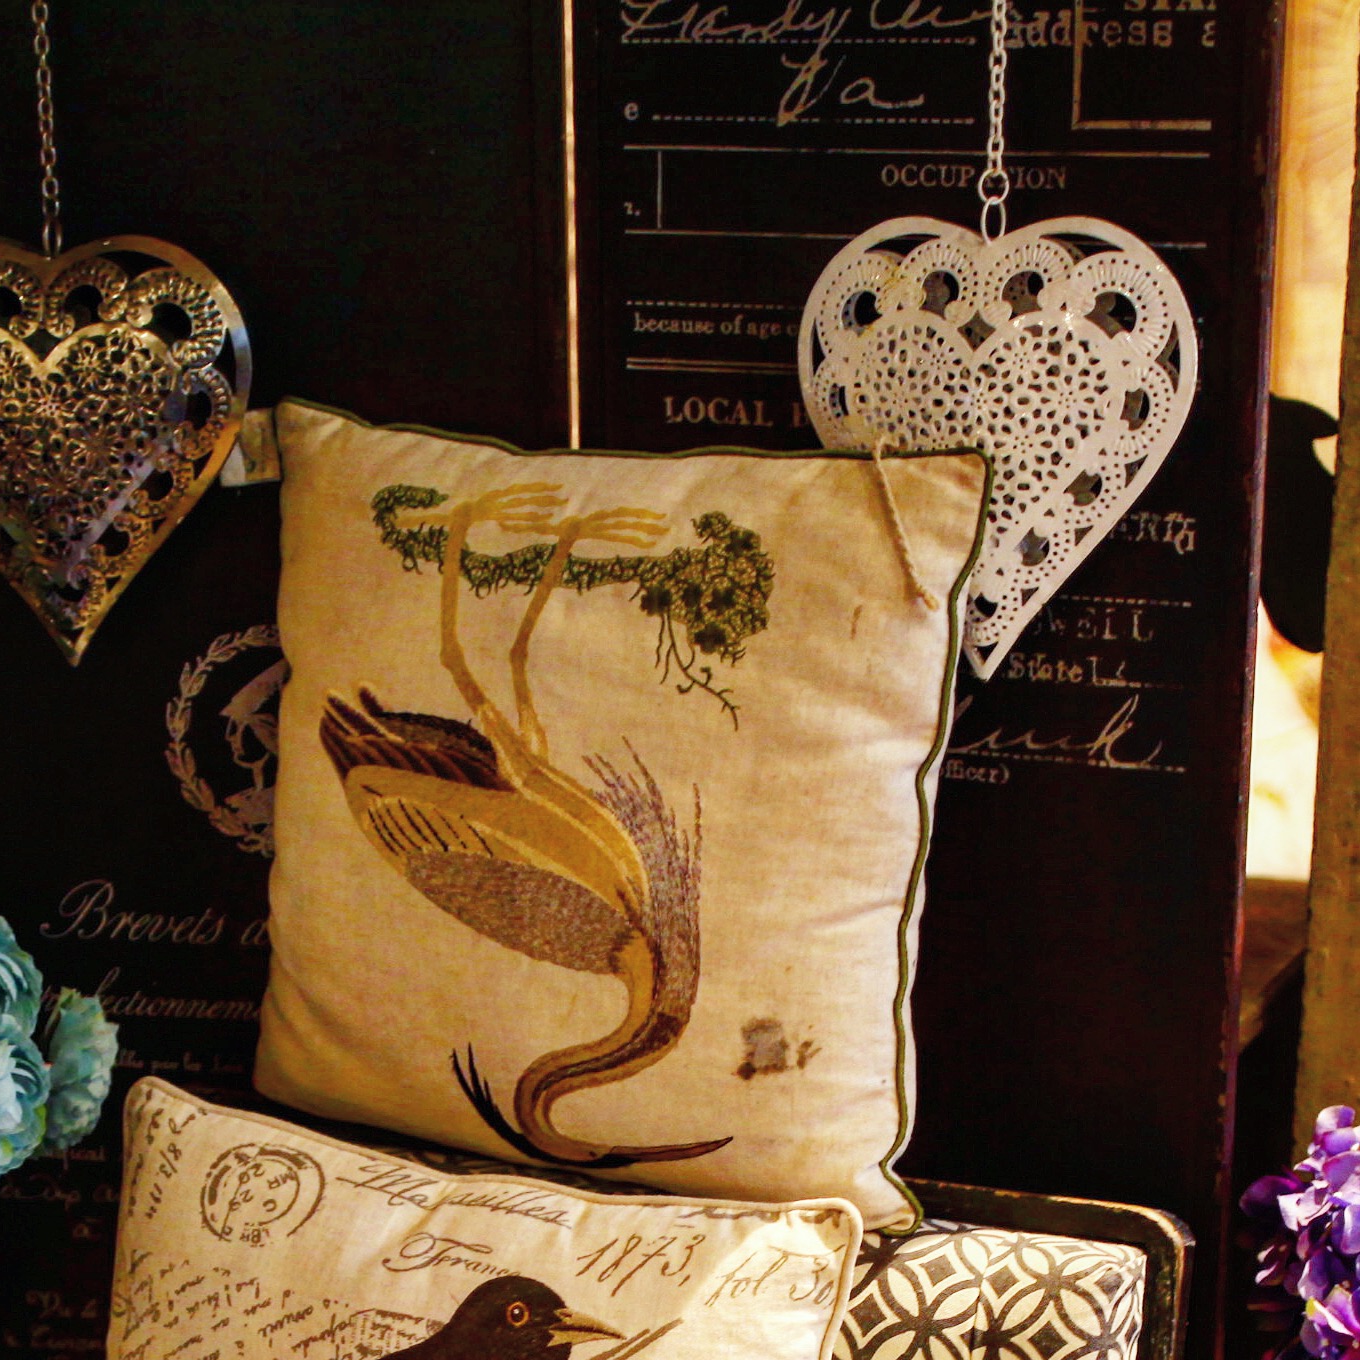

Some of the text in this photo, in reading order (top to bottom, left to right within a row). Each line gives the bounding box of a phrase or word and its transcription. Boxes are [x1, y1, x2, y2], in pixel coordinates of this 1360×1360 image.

[880, 162, 1067, 191] OCCUPTION
[633, 309, 715, 335] because
[720, 312, 744, 336] of
[747, 321, 781, 340] age
[662, 394, 774, 427] LOCAL
[1008, 652, 1084, 684] State
[39, 877, 227, 944] Brevets
